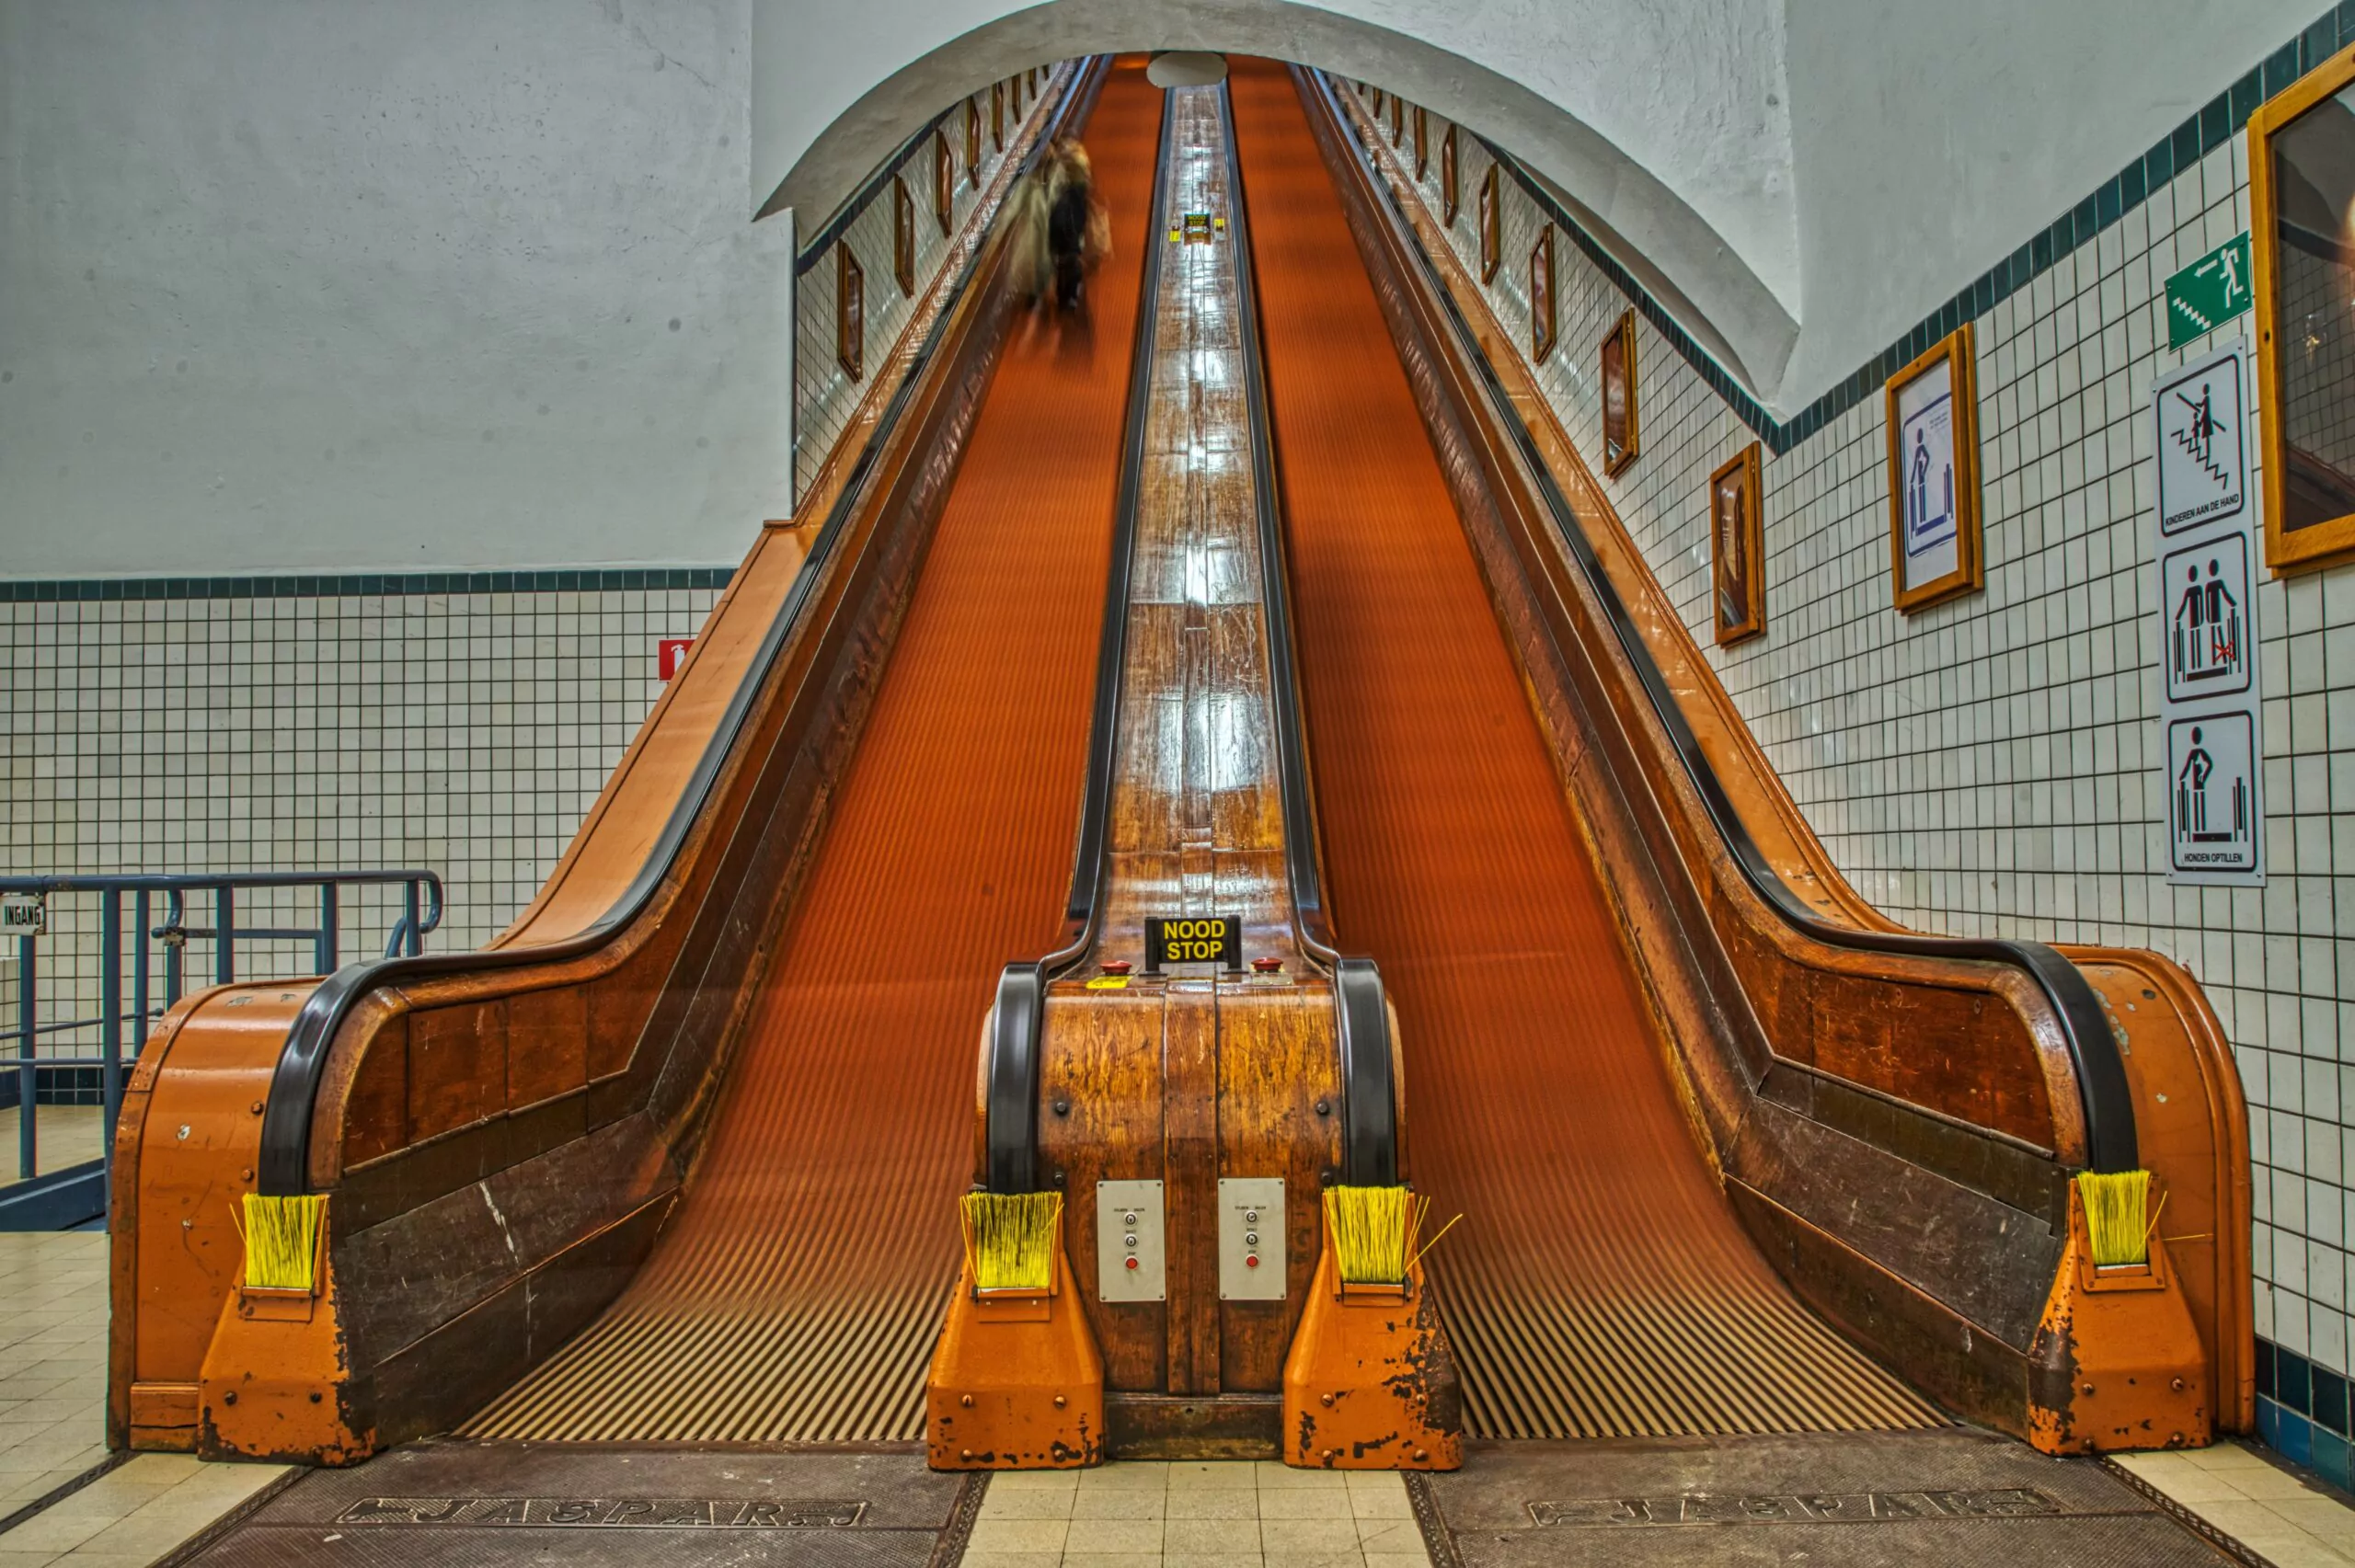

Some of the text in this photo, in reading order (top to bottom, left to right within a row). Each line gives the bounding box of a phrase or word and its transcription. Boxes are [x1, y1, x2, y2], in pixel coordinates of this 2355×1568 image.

[2165, 493, 2239, 527] KINDEREN AAN DE HAND
[2184, 853, 2243, 863] HONDEN OPTILLEN
[5, 905, 40, 925] INGANG
[1164, 920, 1225, 940] NOOD
[1166, 940, 1223, 960] STOP
[414, 1498, 784, 1527] JASPAR
